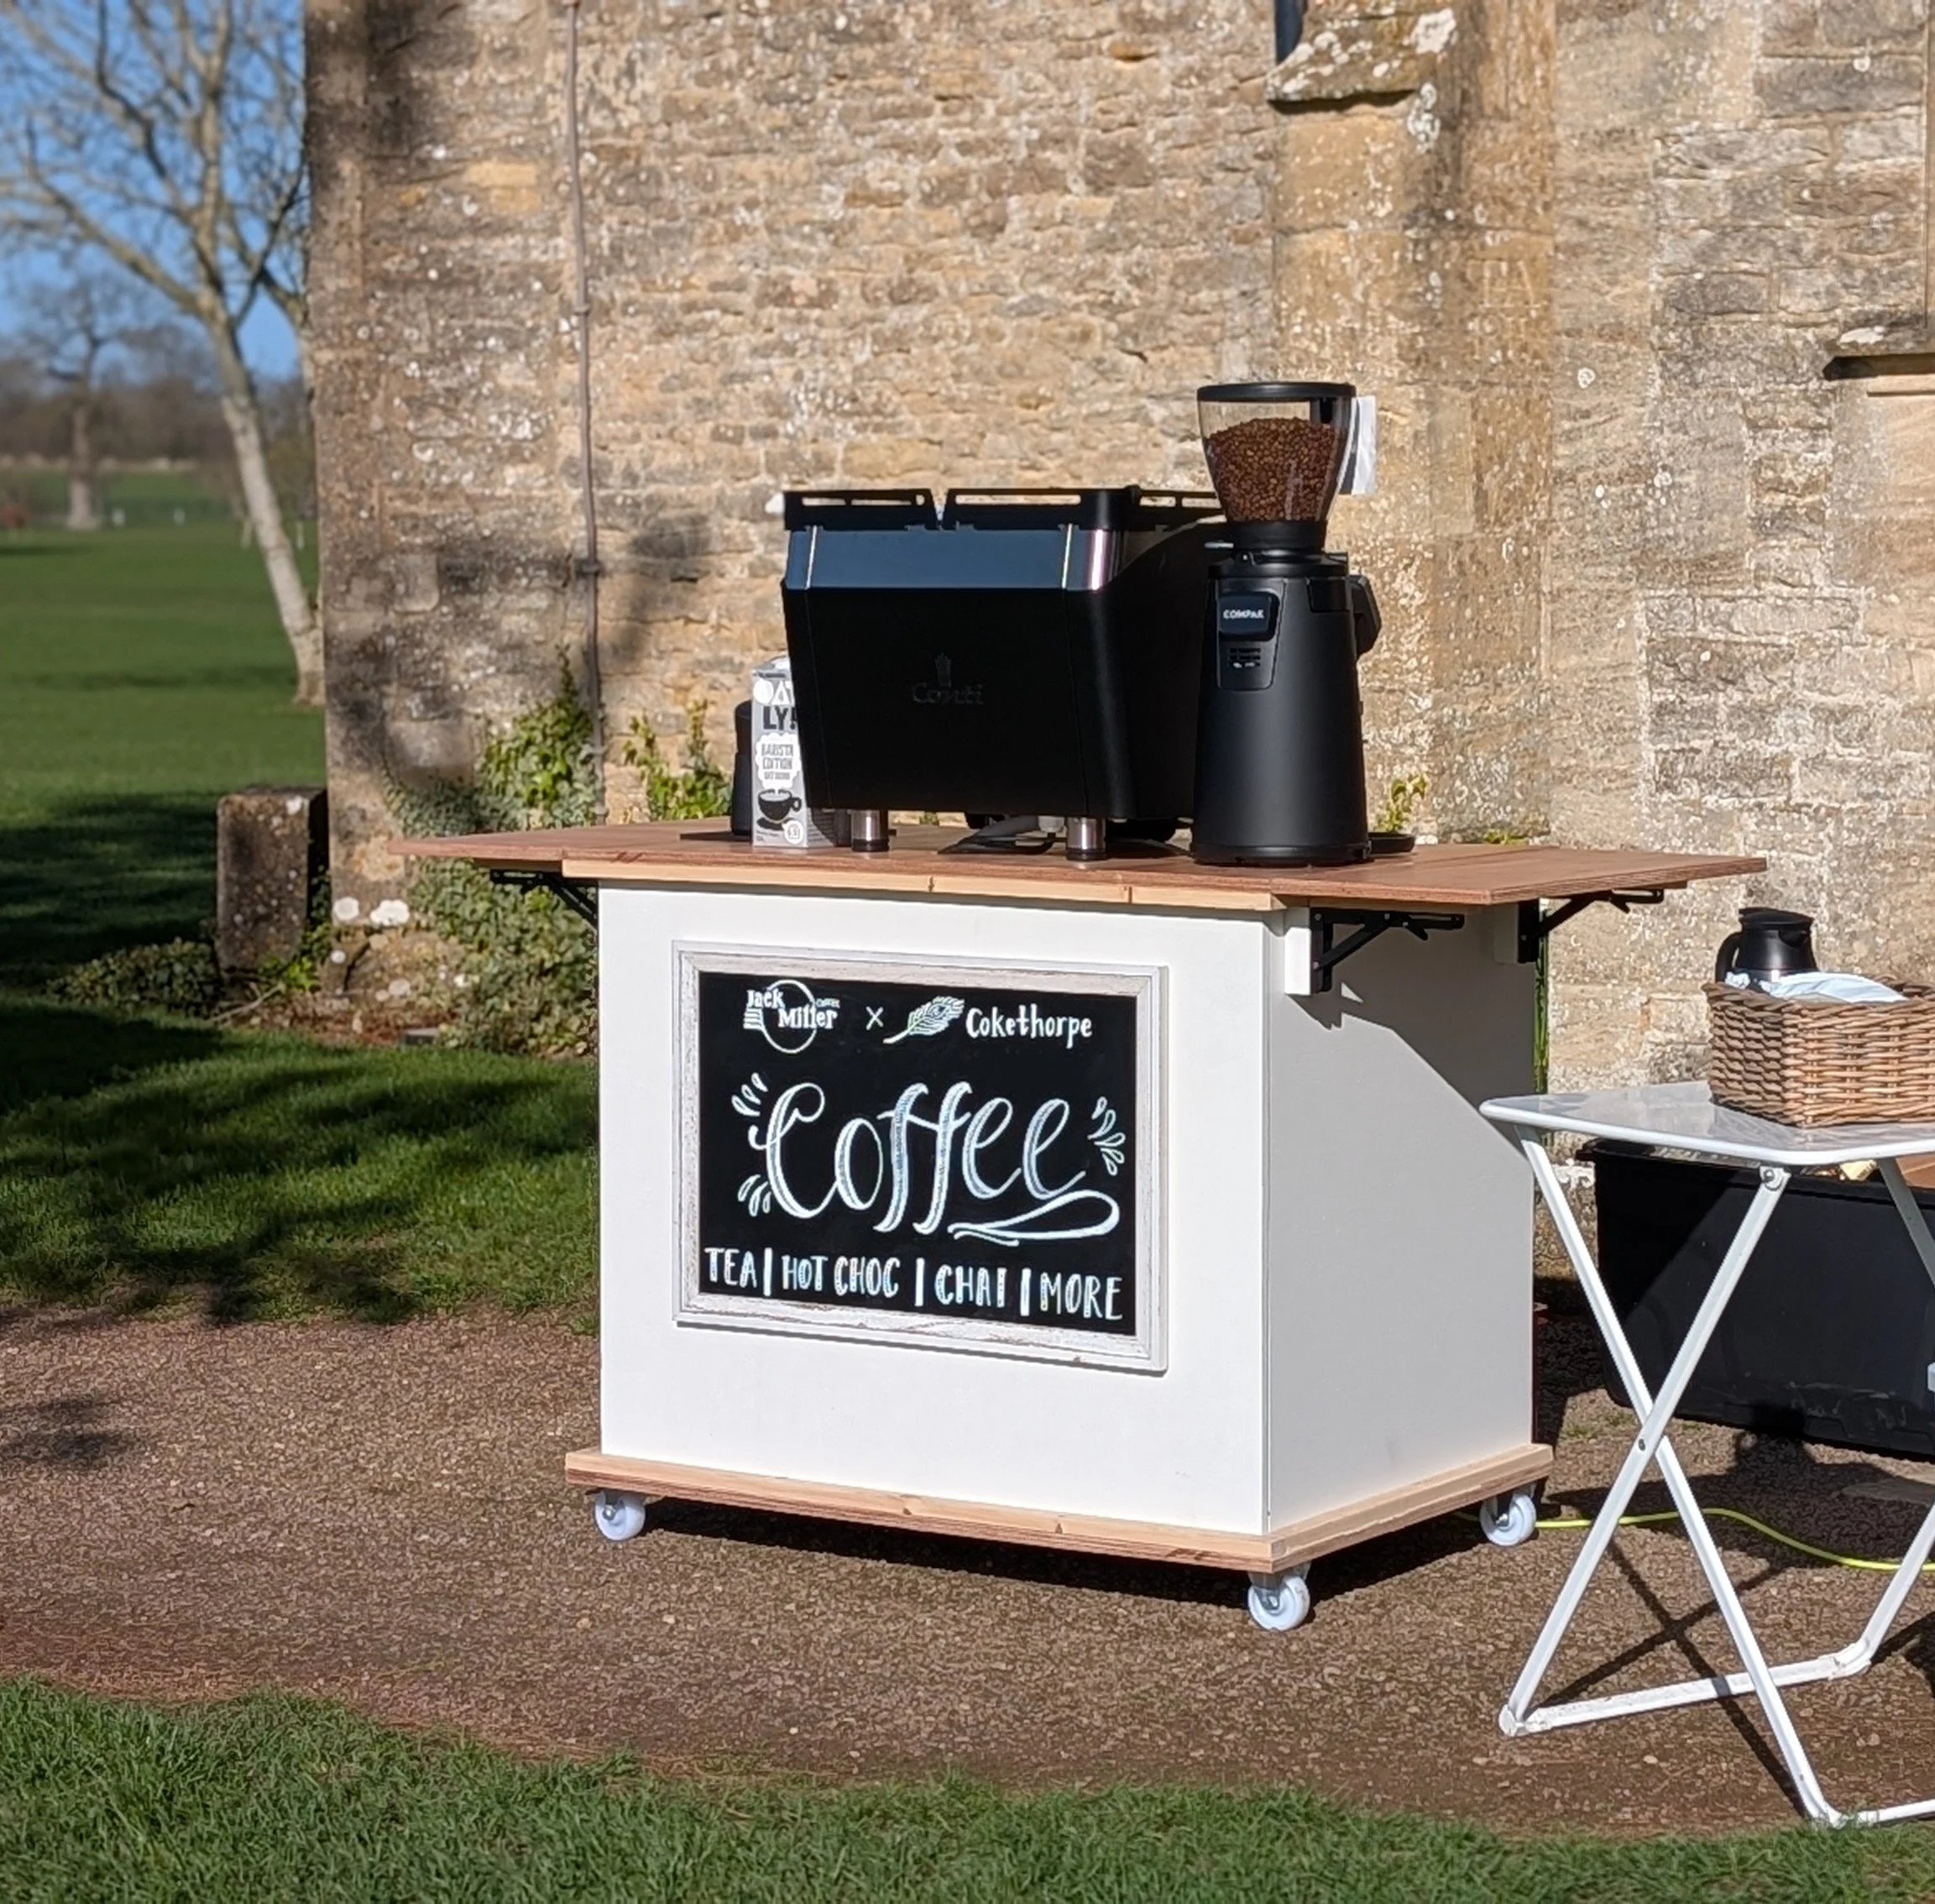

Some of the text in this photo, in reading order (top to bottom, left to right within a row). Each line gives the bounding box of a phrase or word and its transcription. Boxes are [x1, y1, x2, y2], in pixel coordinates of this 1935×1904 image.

[1222, 609, 1265, 620] COMPAK
[746, 988, 786, 1009] Jack
[777, 1003, 838, 1029] Miller
[965, 1003, 1092, 1049] Cokethorpe
[749, 1081, 1088, 1235] Coffee
[704, 1247, 1123, 1321] TEA HOT CHOC CHAI MORE
